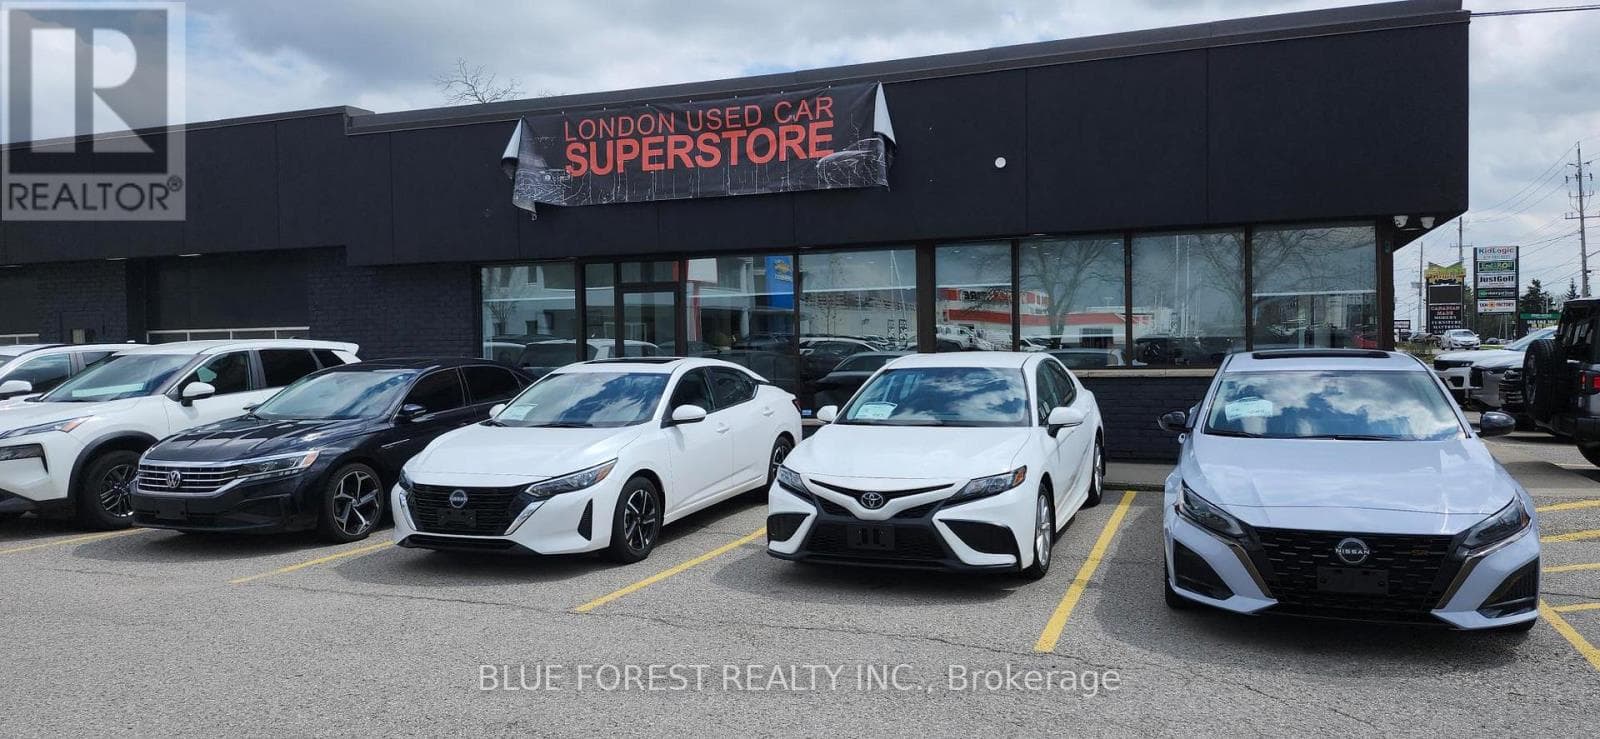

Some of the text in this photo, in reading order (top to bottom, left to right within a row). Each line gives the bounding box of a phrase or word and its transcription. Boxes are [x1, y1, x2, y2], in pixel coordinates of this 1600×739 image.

[564, 96, 835, 142] LONDON USED CAR
[565, 121, 835, 178] SUPERSTORE
[1479, 275, 1514, 283] JustGolf
